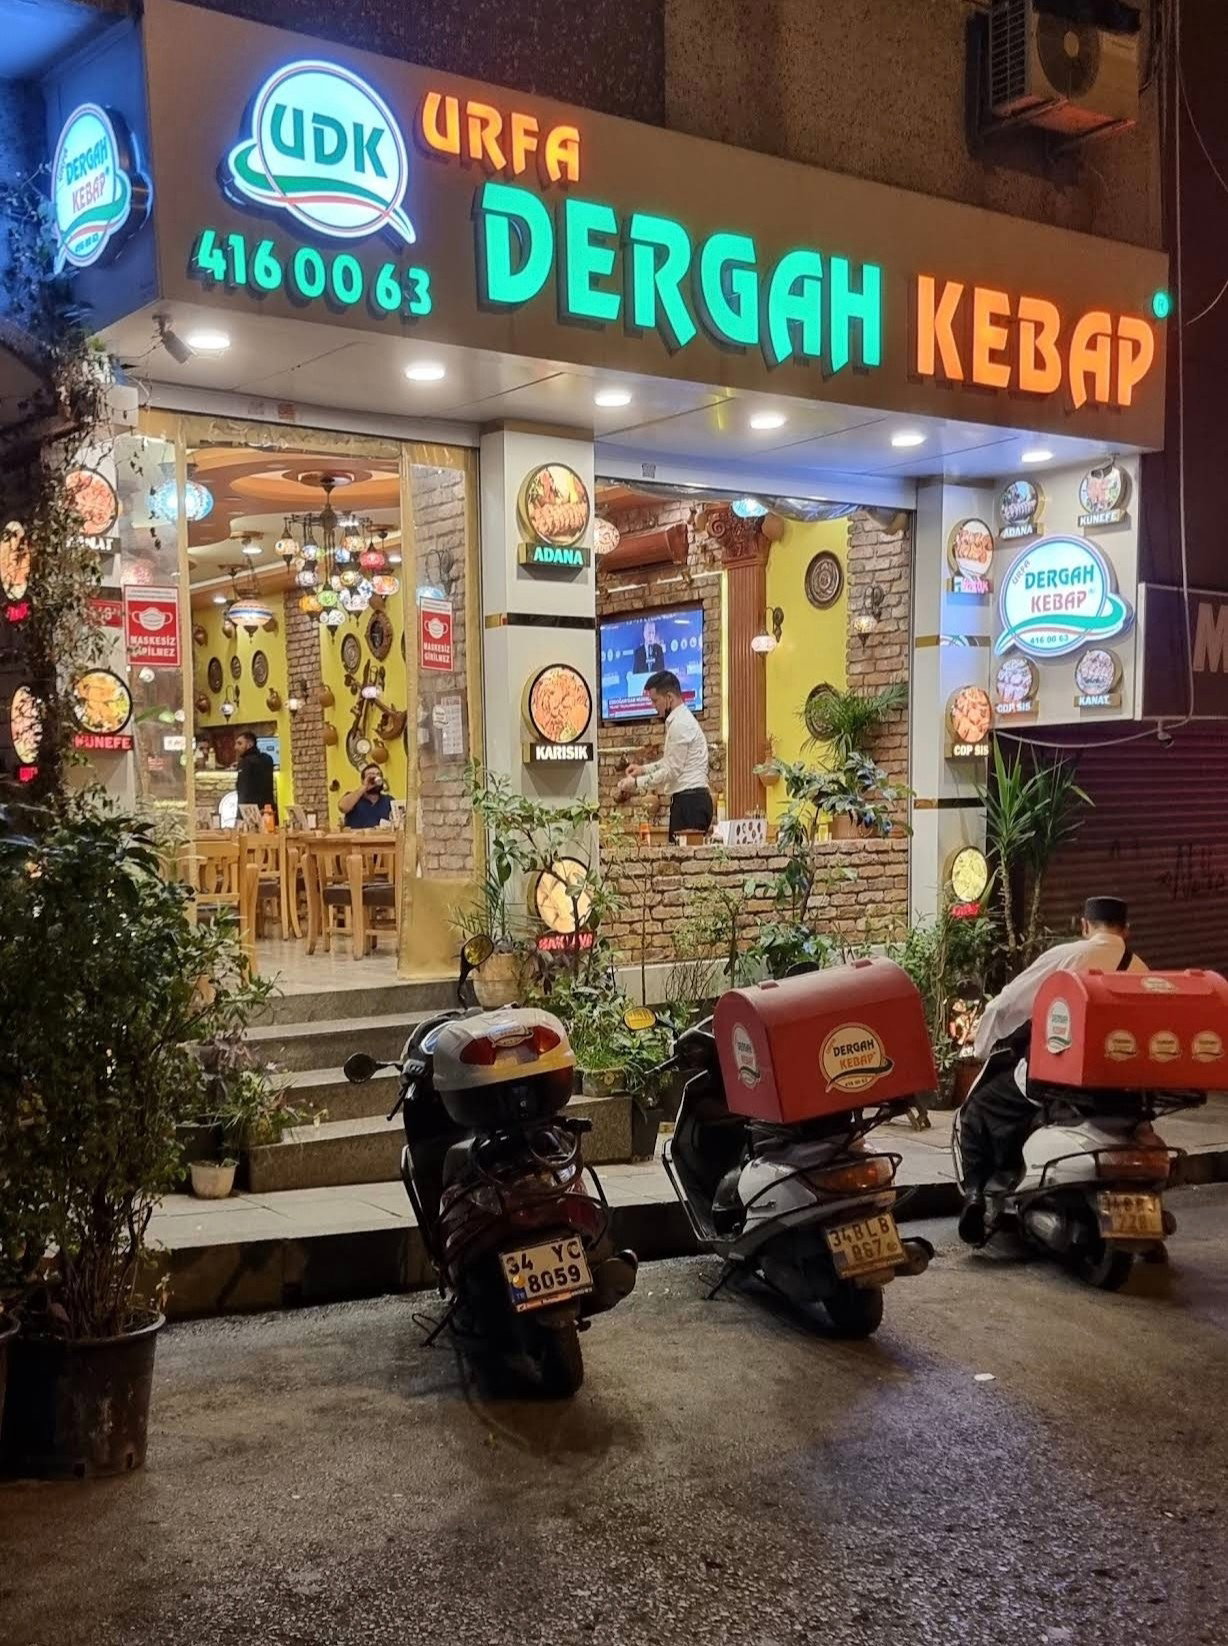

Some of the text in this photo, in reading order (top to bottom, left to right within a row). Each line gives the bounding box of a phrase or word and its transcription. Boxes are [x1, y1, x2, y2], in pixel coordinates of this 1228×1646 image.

[270, 103, 386, 178] UDK
[421, 91, 580, 182] URFA
[66, 137, 109, 185] DERGAH
[72, 172, 106, 214] KEBAP
[198, 230, 432, 316] 416 00 63
[481, 183, 882, 373] DERGAH
[916, 275, 1155, 409] KEBAP
[1000, 524, 1033, 539] ADANA
[533, 546, 584, 565] ADANA
[1012, 559, 1031, 585] URFA
[1025, 564, 1095, 590] DERGAH
[1031, 591, 1087, 613] KEBAP
[1079, 695, 1110, 705] KANAT
[833, 1039, 874, 1057] DERGAH
[840, 1053, 874, 1069] KEBAP
[506, 1241, 581, 1275] 34 YC
[528, 1264, 581, 1293] 8059
